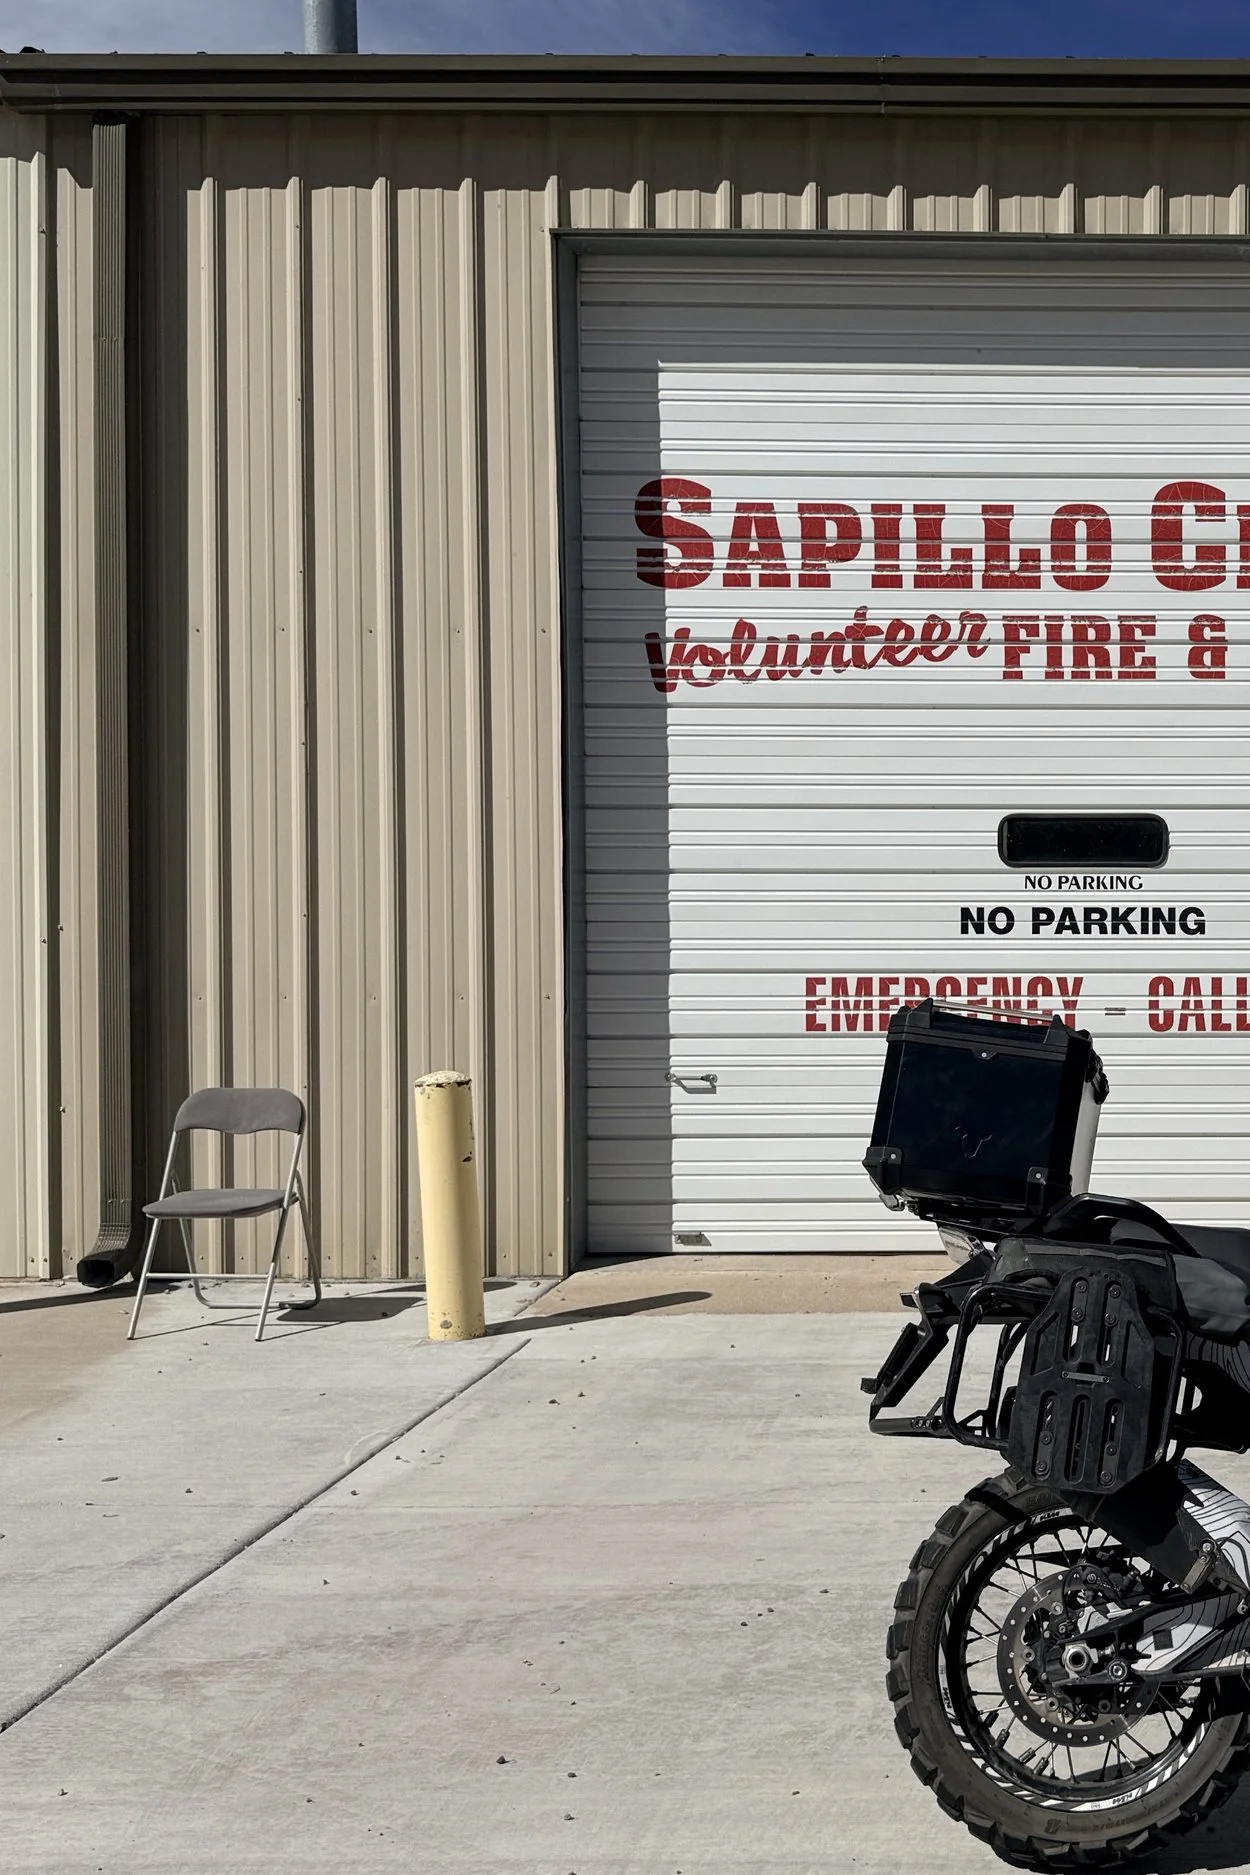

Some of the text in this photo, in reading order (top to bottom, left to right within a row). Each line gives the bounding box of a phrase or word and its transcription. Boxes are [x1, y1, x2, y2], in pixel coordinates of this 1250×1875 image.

[634, 478, 1112, 590] SAPILLO
[645, 605, 991, 693] Volunteer
[1002, 614, 1157, 680] FIRE
[1188, 614, 1228, 680] &
[1024, 875, 1143, 890] NO PARKING
[960, 906, 1206, 936] NO PARKING
